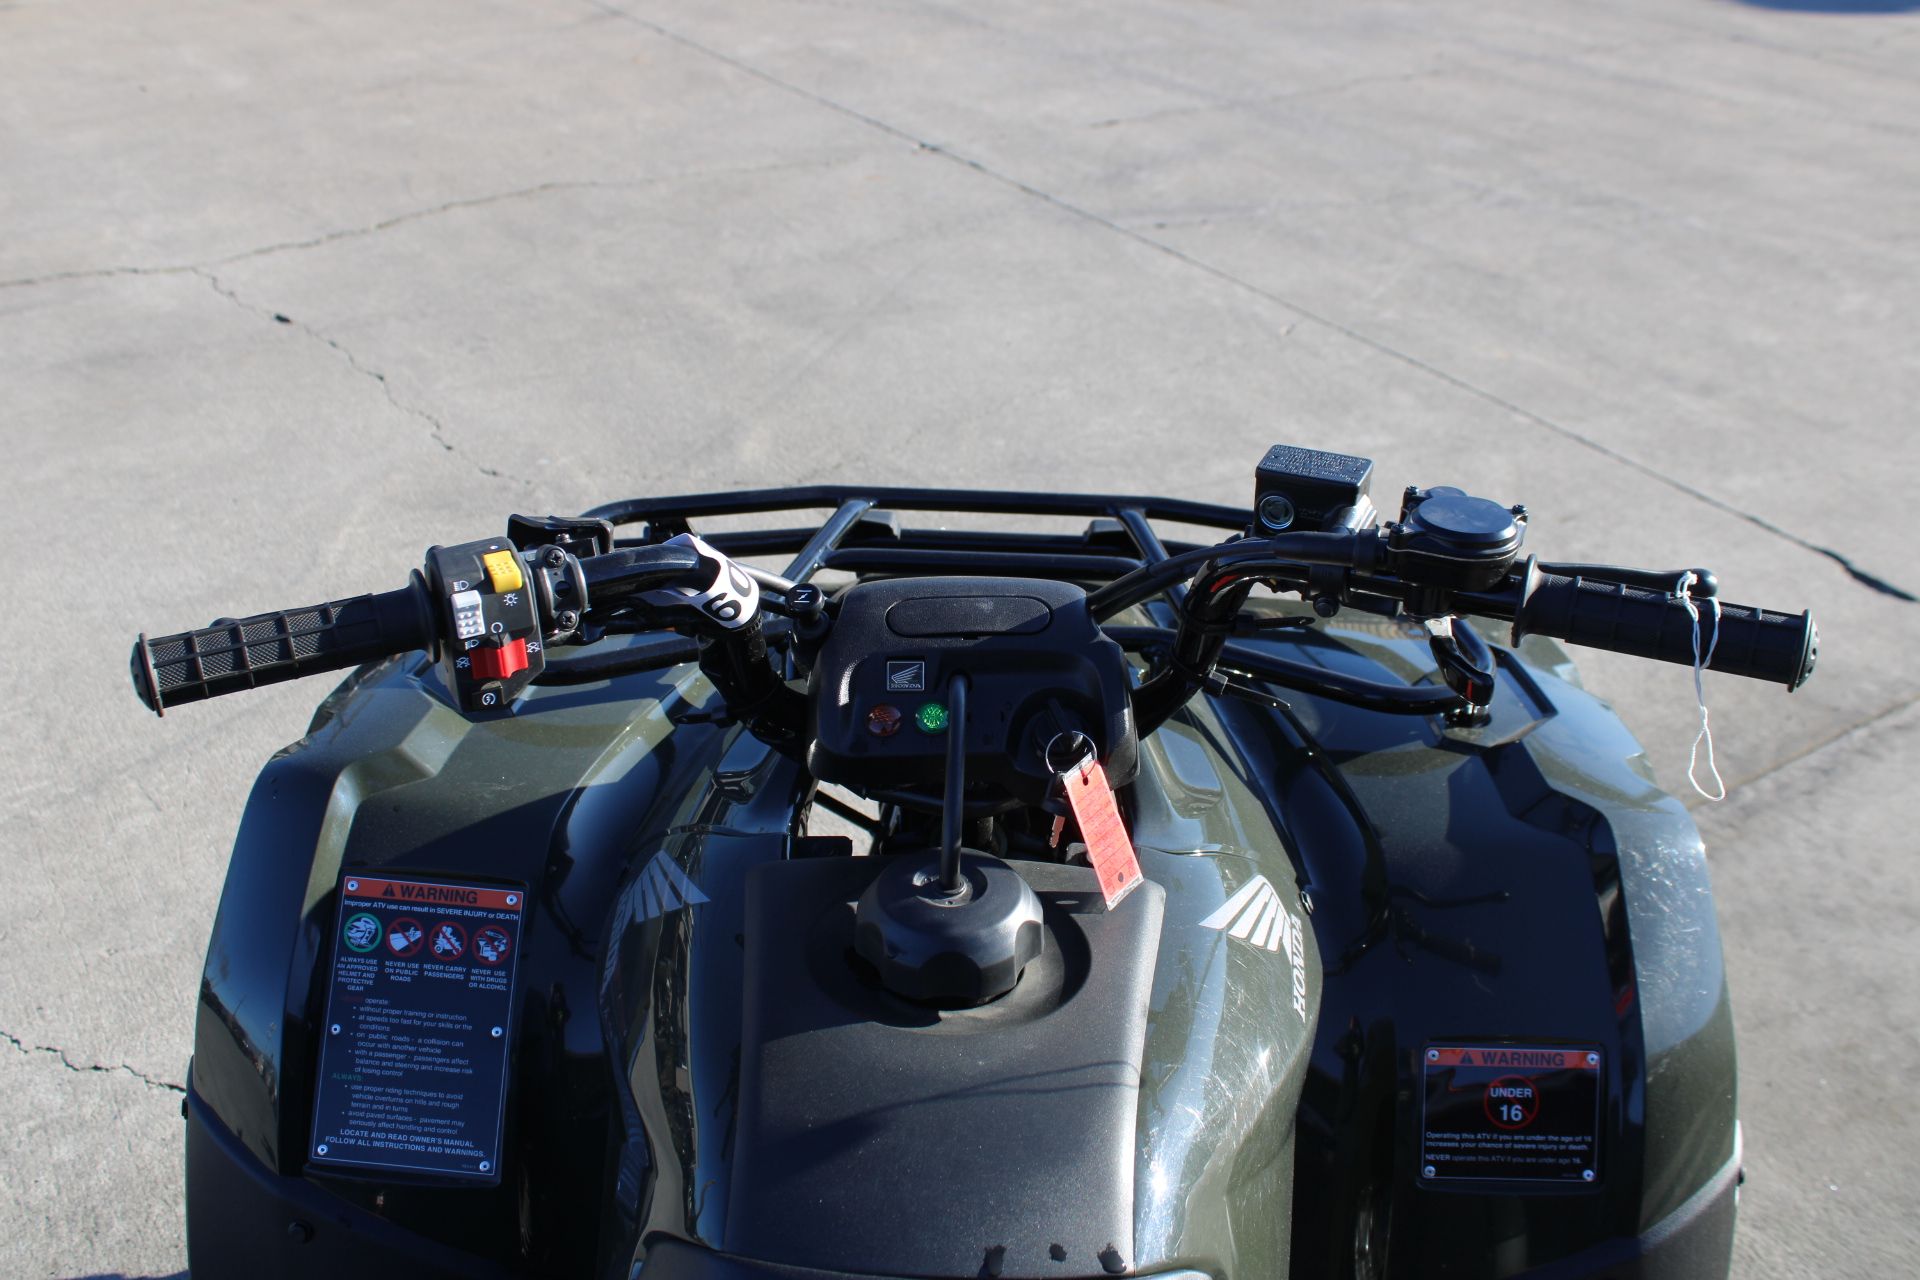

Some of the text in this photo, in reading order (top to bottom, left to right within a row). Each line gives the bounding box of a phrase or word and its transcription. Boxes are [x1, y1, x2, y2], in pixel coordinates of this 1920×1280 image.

[401, 885, 478, 904] WARNING
[344, 900, 372, 909] Improper
[437, 907, 462, 916] SEVERE
[464, 909, 487, 918] INJURY
[340, 956, 365, 964] ALWAYS
[385, 960, 406, 968] NEVER
[346, 964, 378, 972] APPROVED
[395, 968, 419, 976] PUBLIC
[445, 965, 467, 973] CARRY
[1290, 913, 1305, 1024] HONDA
[424, 970, 464, 980] PASSENGERS
[337, 977, 374, 985] PROTECTIVE
[486, 976, 507, 984] DRUGS
[479, 983, 507, 991] ALCOHOL
[382, 1008, 403, 1016] proper
[1481, 1051, 1565, 1067] WARNING
[1490, 1087, 1532, 1098] UNDER
[1499, 1104, 1523, 1122] 16
[340, 1128, 369, 1138] LOCATE
[370, 1131, 386, 1139] AND
[387, 1133, 408, 1141] READ
[409, 1135, 442, 1145] OWNER'S
[1425, 1131, 1460, 1140] Operating
[325, 1135, 356, 1145] FOLLOW
[372, 1140, 426, 1152] INSTRUCTIONS
[1425, 1153, 1451, 1161] NEVER
